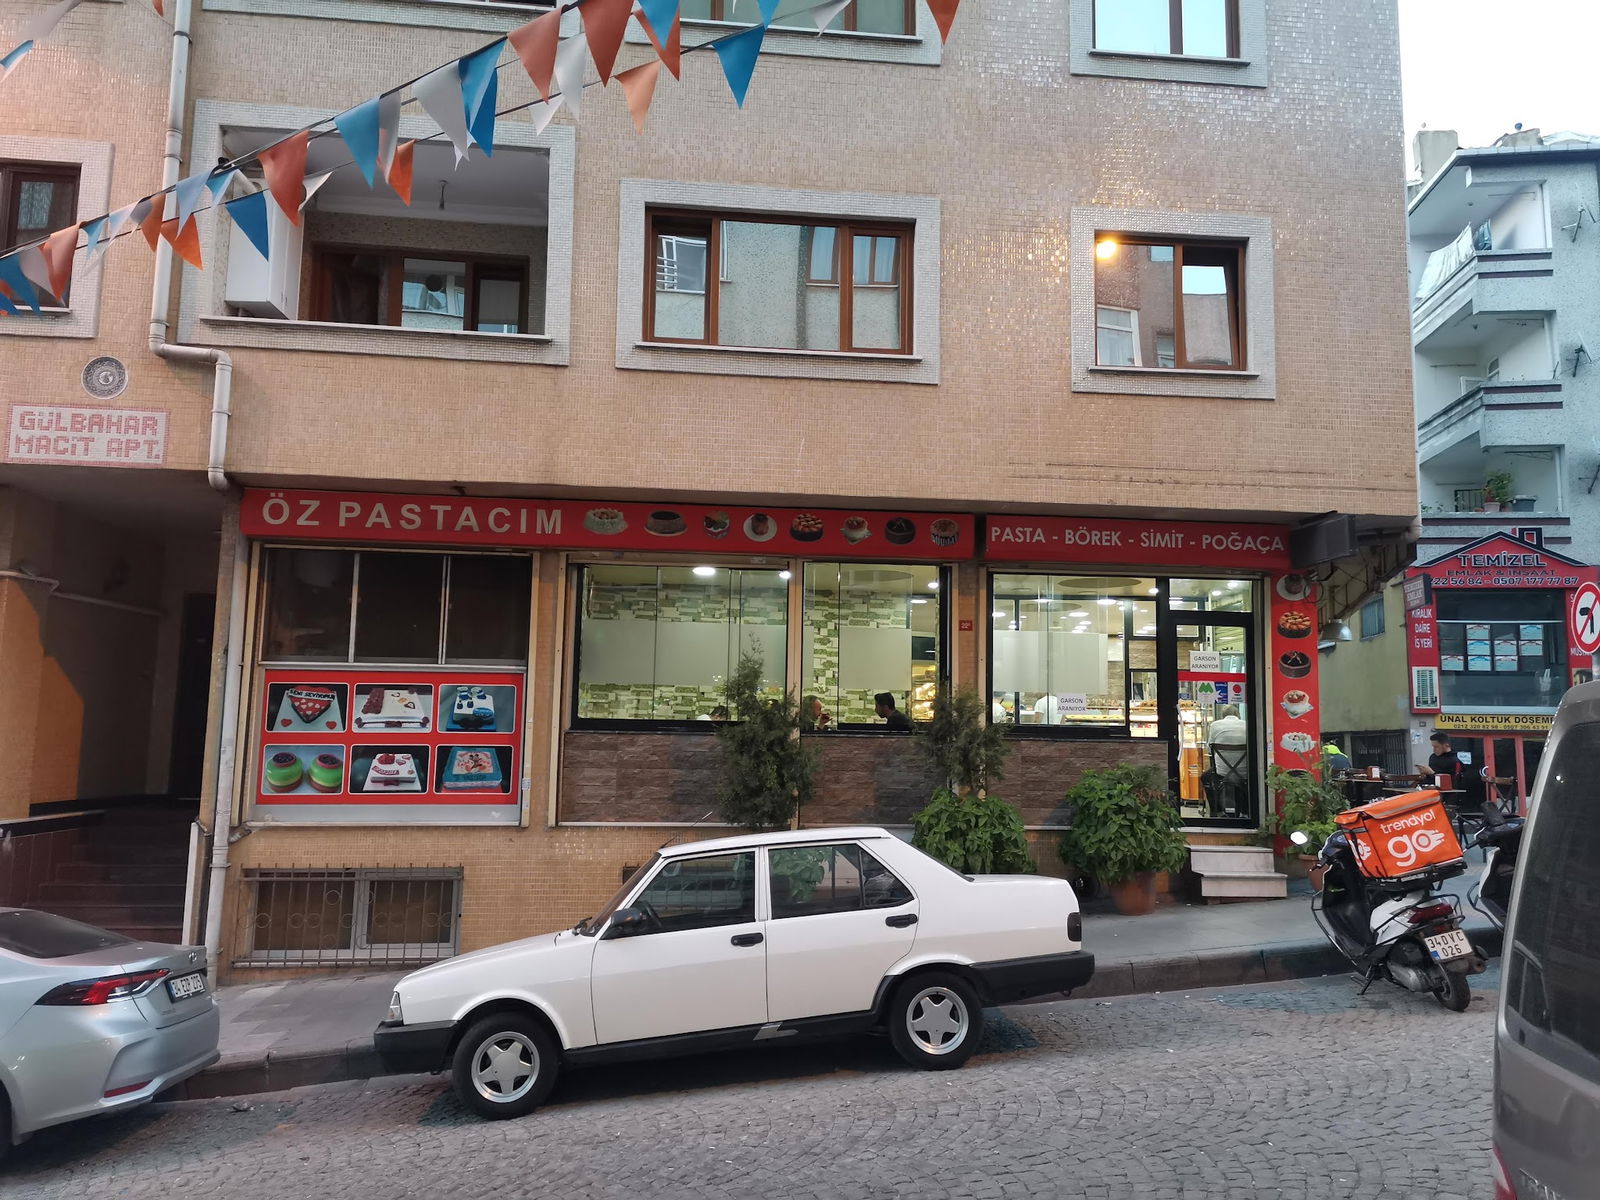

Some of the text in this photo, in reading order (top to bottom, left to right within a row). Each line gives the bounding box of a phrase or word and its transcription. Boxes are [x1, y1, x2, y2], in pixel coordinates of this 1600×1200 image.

[18, 410, 158, 436] GÜLBAHAR
[106, 437, 161, 460] APT.
[261, 492, 562, 535] ÖZ PASTACIM
[990, 526, 1046, 544] PASTA
[1064, 526, 1122, 547] BÖREK
[1140, 529, 1185, 549] SİMİT
[1202, 531, 1285, 554] POĞAÇA
[1457, 551, 1547, 567] TEMİZEL
[1450, 577, 1465, 586] 56
[1467, 577, 1483, 586] 84
[1493, 577, 1522, 586] 0507
[1525, 577, 1544, 586] 177
[1547, 577, 1562, 586] 77
[1563, 577, 1579, 586] 87
[1470, 715, 1511, 724] KOLTUK
[1380, 809, 1436, 834] trendyol
[1387, 829, 1445, 867] go
[1441, 944, 1462, 957] 026
